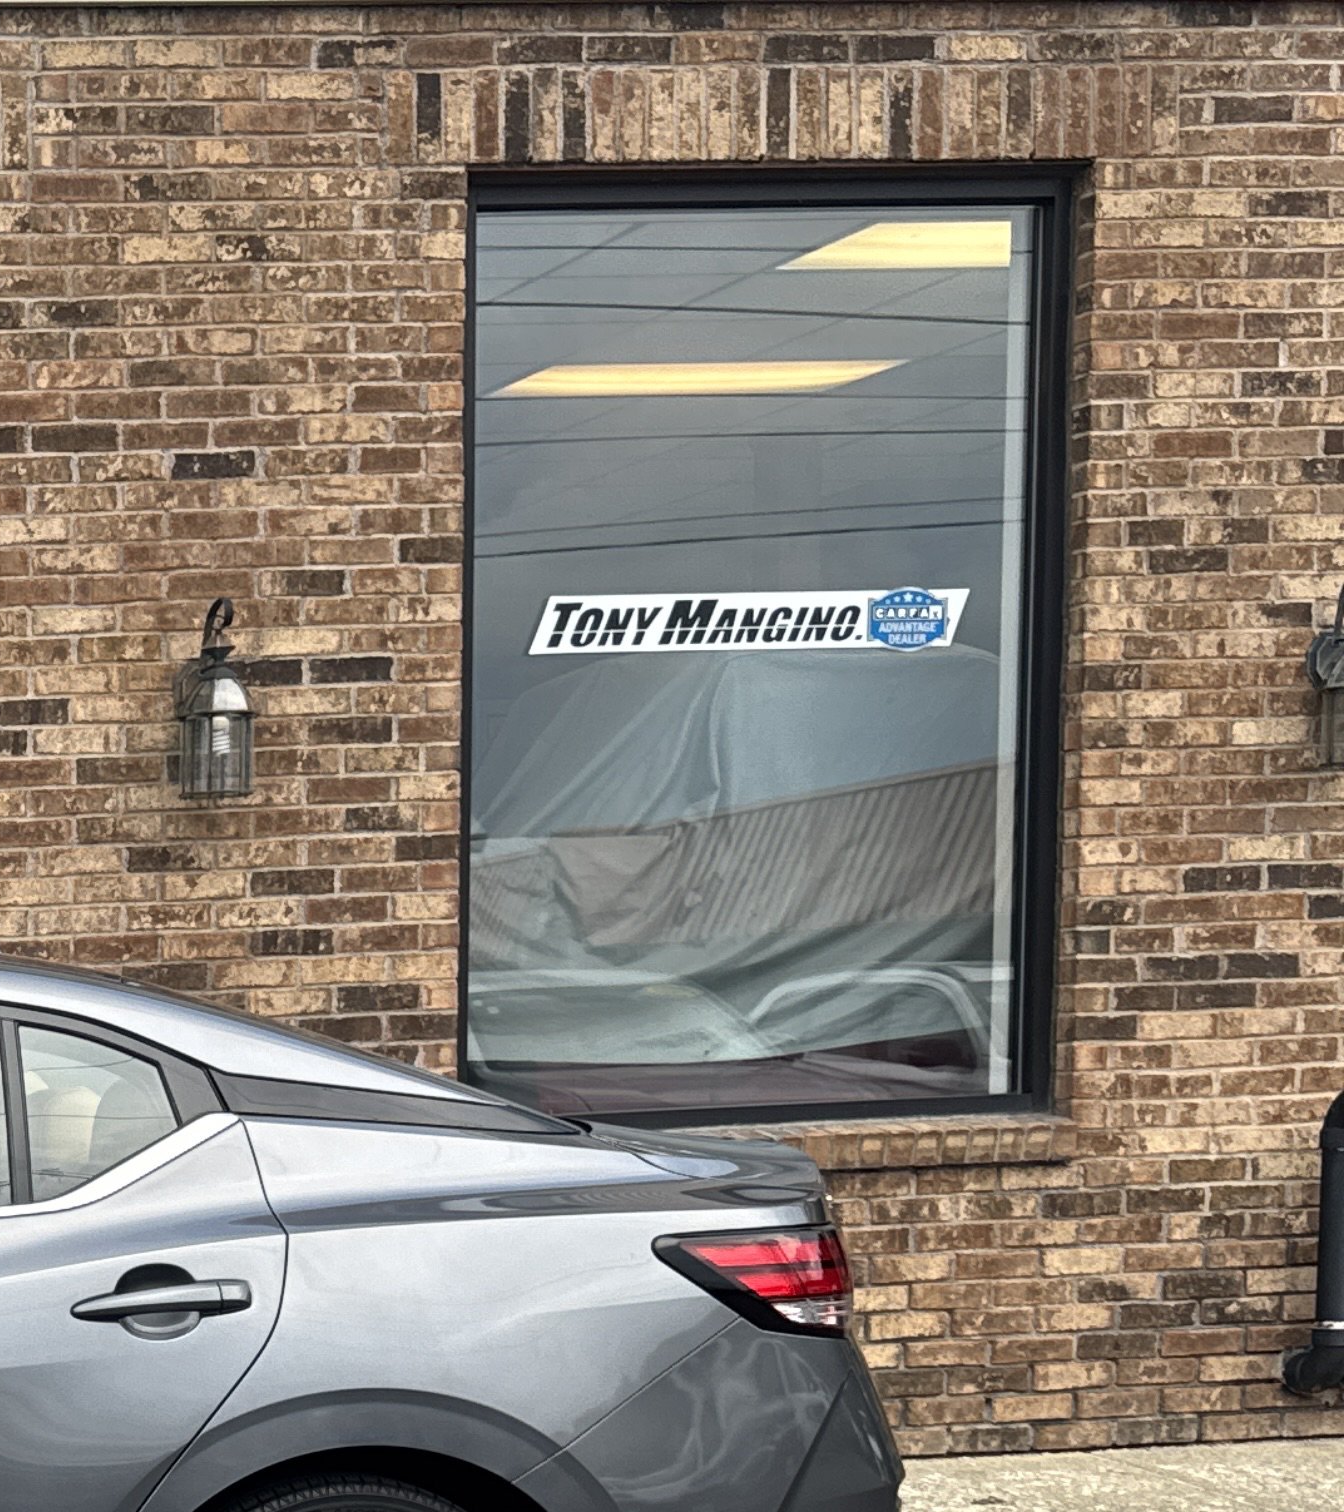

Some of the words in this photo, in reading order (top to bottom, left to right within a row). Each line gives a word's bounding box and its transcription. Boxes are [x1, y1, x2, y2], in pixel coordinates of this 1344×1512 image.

[874, 606, 943, 619] CARFAX
[547, 602, 663, 648] TONY
[878, 621, 937, 633] ADVANTAGE
[888, 633, 927, 645] DEALER
